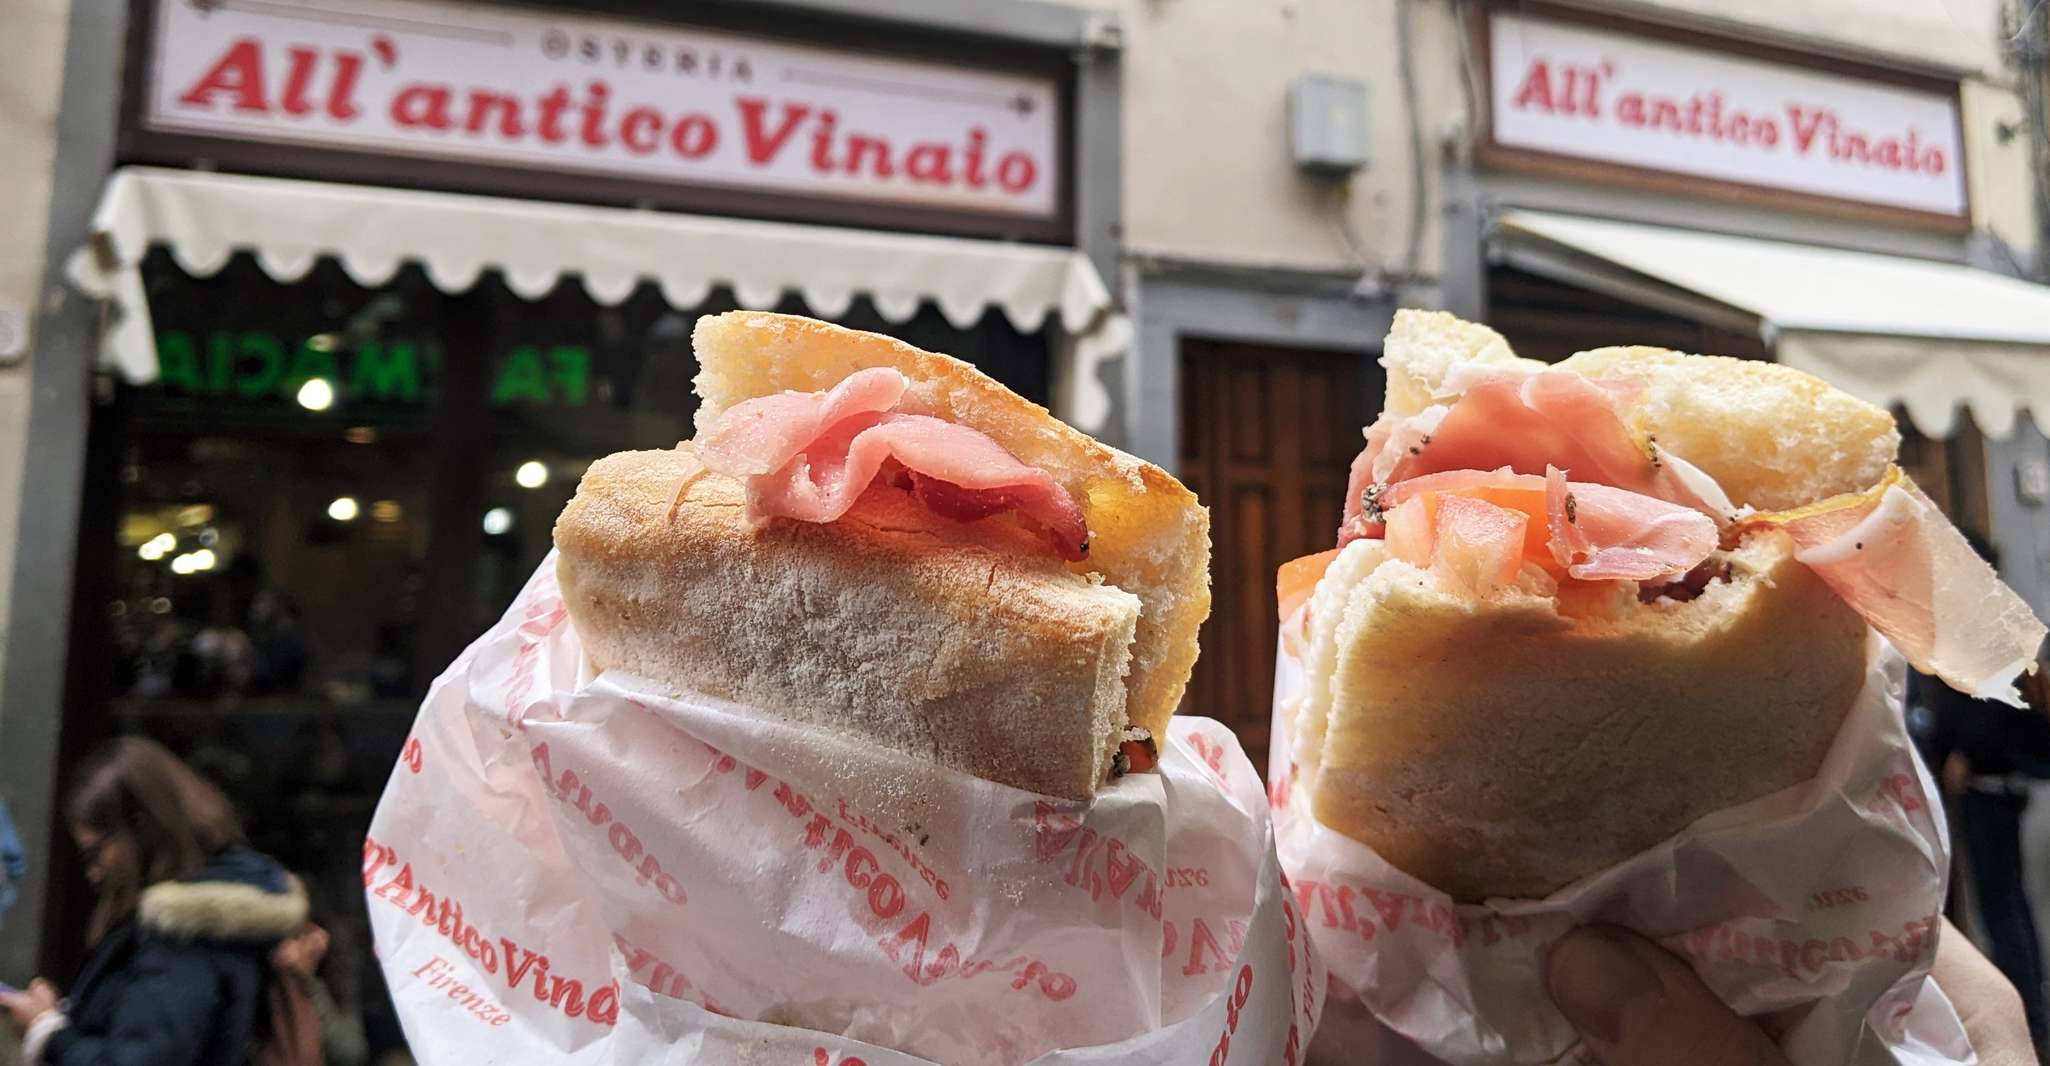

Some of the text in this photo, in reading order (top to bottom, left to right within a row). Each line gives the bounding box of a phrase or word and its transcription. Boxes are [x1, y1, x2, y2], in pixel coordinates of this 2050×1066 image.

[540, 28, 755, 83] OSTERIA
[734, 95, 1038, 194] Vinaio
[1784, 104, 1946, 177] Vinaio
[412, 955, 512, 1027] Firenze
